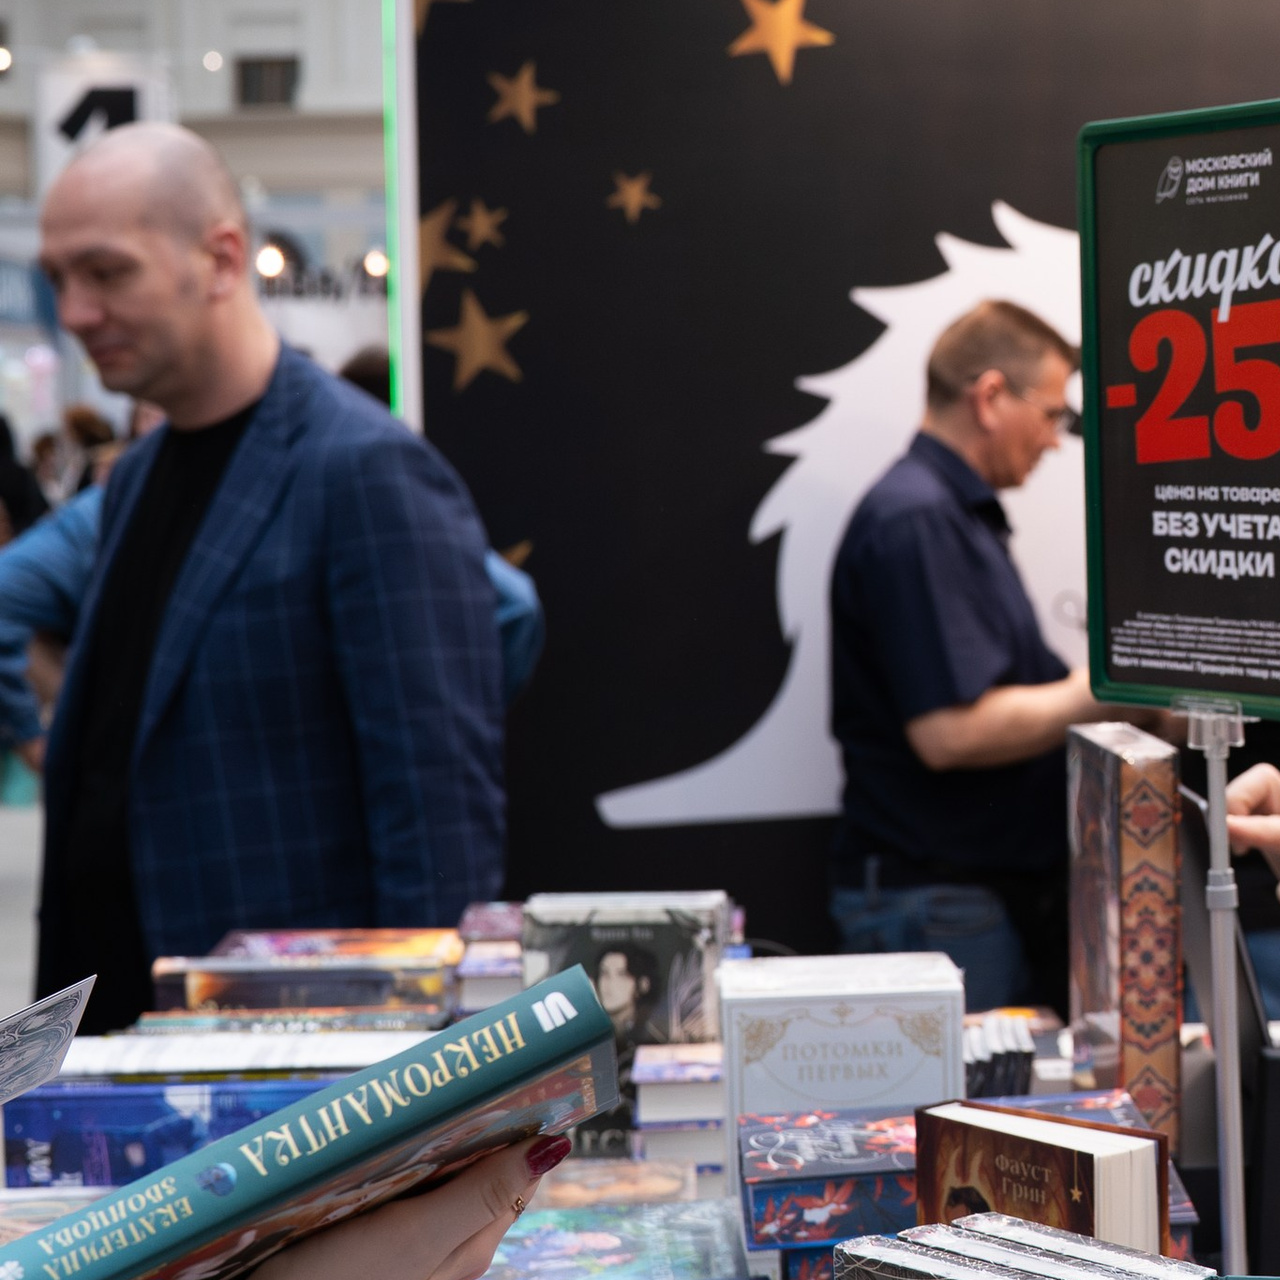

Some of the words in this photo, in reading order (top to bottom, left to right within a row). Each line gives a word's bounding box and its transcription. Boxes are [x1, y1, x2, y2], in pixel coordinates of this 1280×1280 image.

[1198, 486, 1219, 502] на
[1152, 511, 1200, 538] БЕЗ
[1164, 547, 1275, 580] СКИДКИ
[239, 1012, 526, 1176] НЕКРОМАНТКА
[37, 1176, 177, 1255] ЗВОНЦОВА
